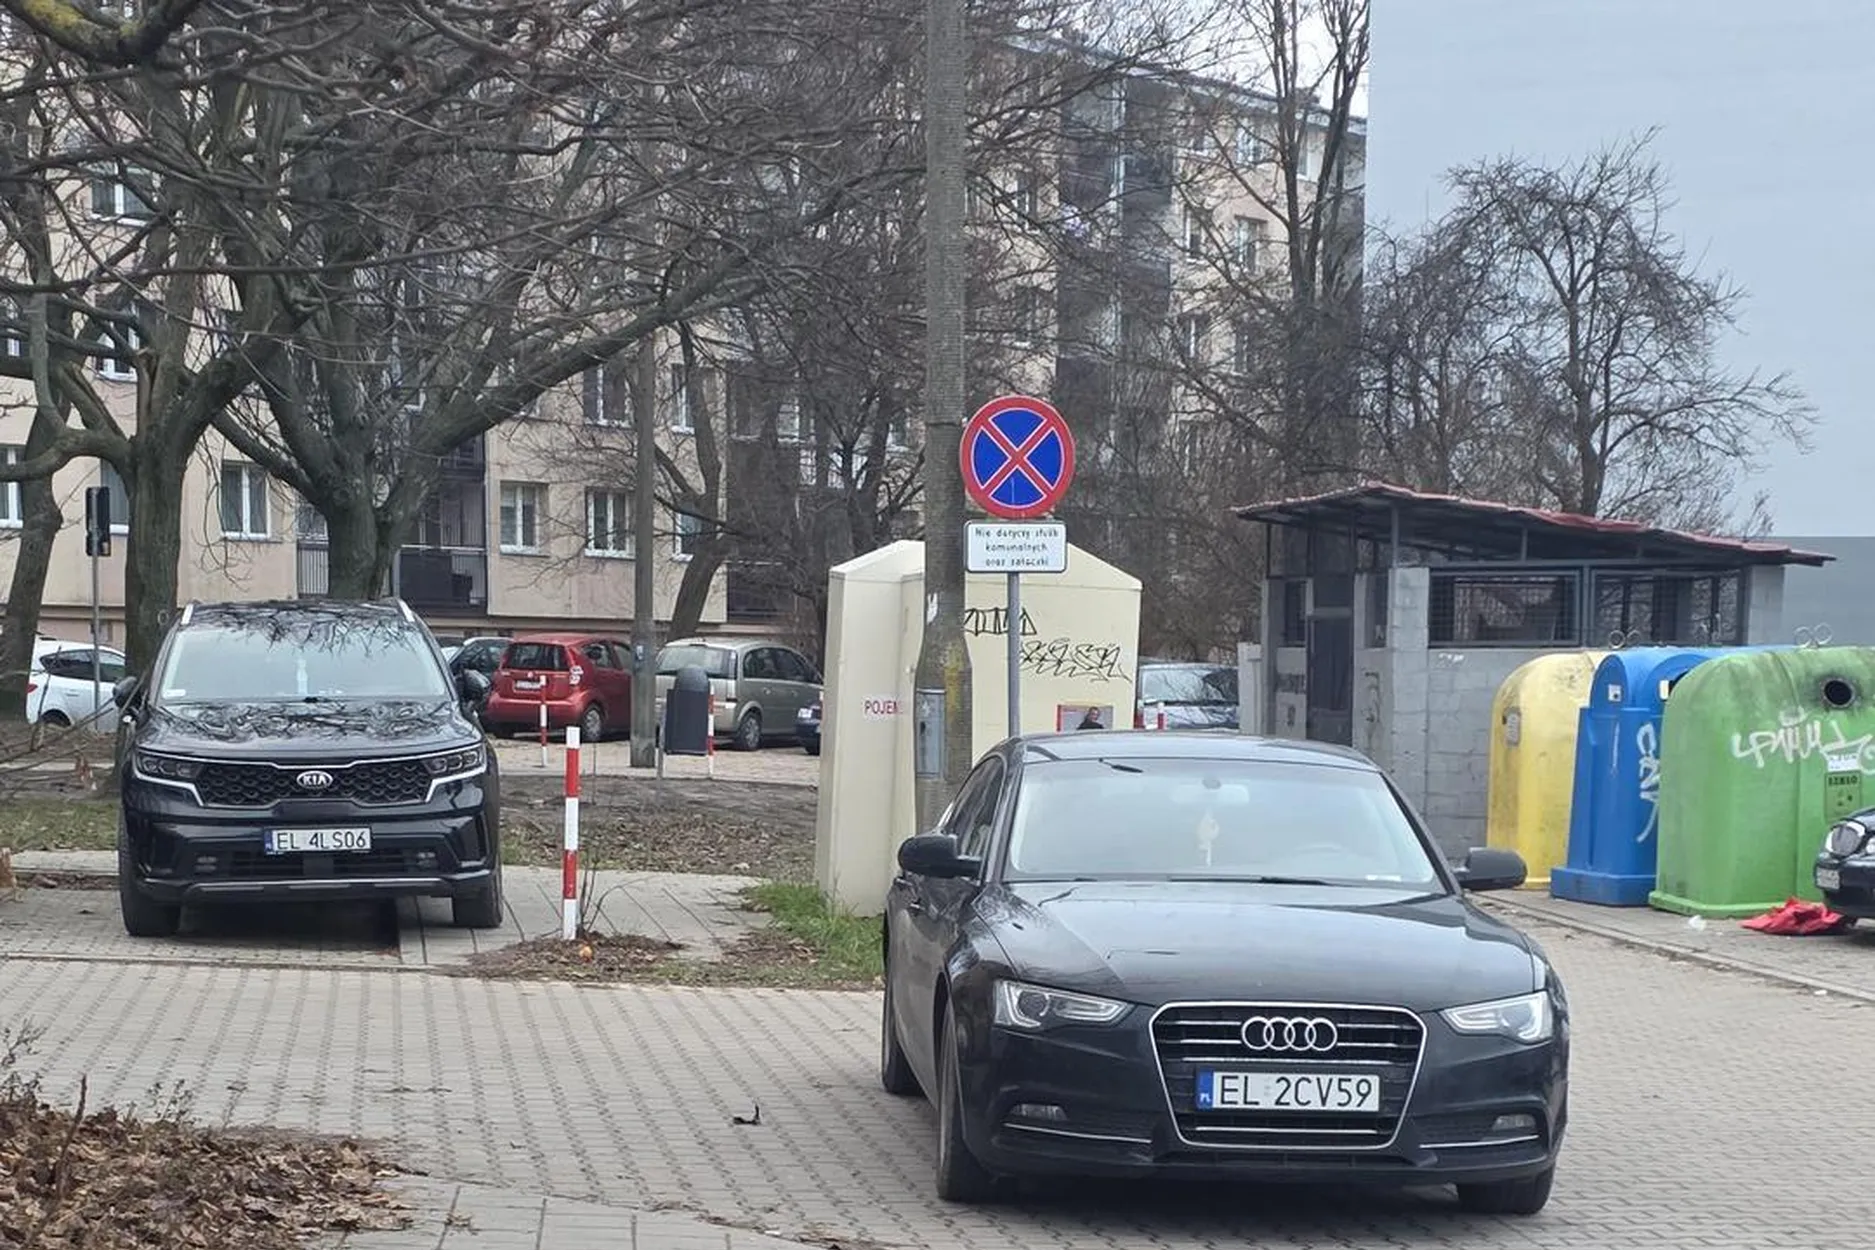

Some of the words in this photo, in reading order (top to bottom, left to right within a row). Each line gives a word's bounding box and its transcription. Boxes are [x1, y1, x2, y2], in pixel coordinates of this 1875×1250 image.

[974, 527, 990, 537] Nie
[985, 543, 1046, 553] komunalnych
[302, 775, 327, 786] KIA
[277, 832, 300, 850] EL
[308, 831, 367, 849] 4LS06
[1220, 1075, 1260, 1105] EL
[1274, 1076, 1372, 1108] 2CV59
